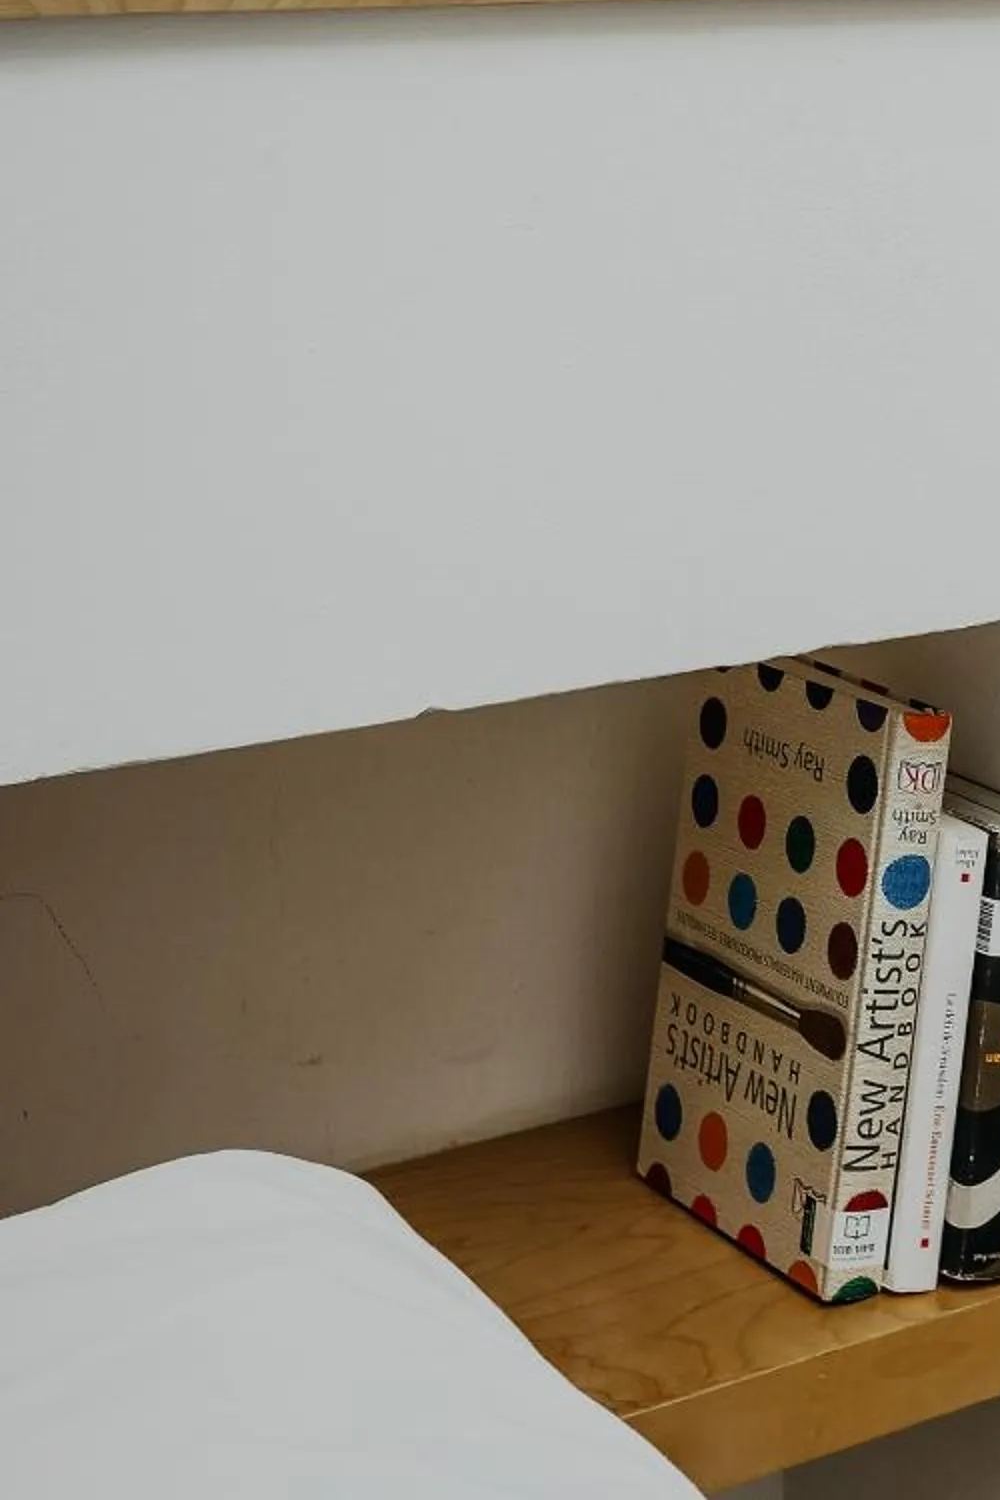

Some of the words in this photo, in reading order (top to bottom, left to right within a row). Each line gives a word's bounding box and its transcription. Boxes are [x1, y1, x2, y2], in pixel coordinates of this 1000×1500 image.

[743, 726, 790, 769] Smith
[794, 741, 825, 782] Ray
[905, 766, 936, 794] DK
[892, 807, 937, 826] Smith
[899, 827, 927, 845] Ray
[857, 919, 908, 1063] Artist's
[666, 1023, 741, 1102] Artist's
[671, 992, 801, 1085] HANDBOOK
[880, 922, 926, 1169] HANDBOOK
[744, 1070, 797, 1140] New
[842, 1079, 888, 1172] New
